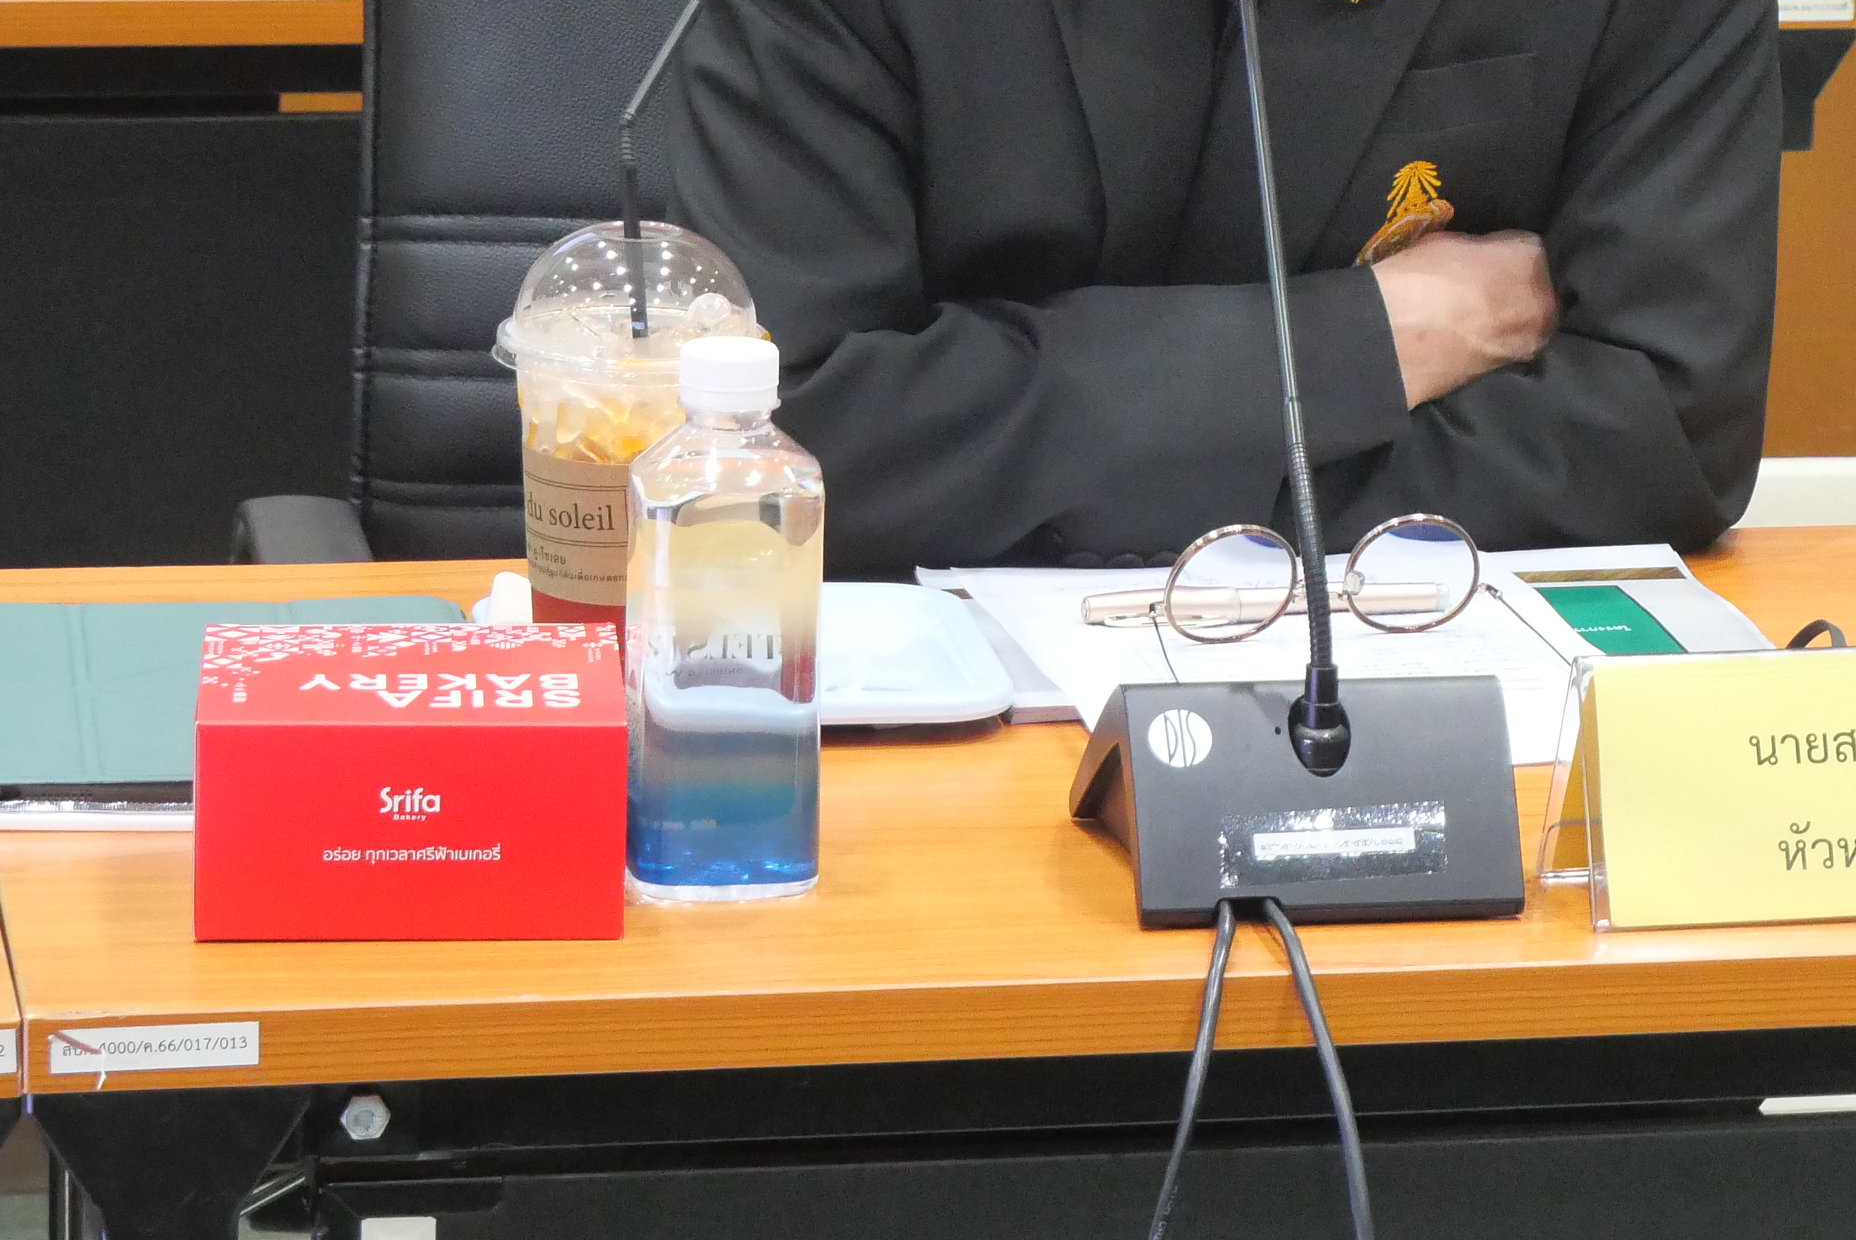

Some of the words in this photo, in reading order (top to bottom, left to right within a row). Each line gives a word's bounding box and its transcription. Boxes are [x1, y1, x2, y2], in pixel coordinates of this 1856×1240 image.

[527, 491, 543, 522] du
[549, 503, 616, 531] soleil
[300, 673, 580, 691] BAKERY
[377, 689, 582, 708] SRIFA
[378, 786, 441, 814] Srifa
[393, 813, 427, 822] Bakery
[322, 846, 361, 861] อร่อย
[365, 842, 501, 866] ทุกเวลาศรีฟ้าเบเกอรี่
